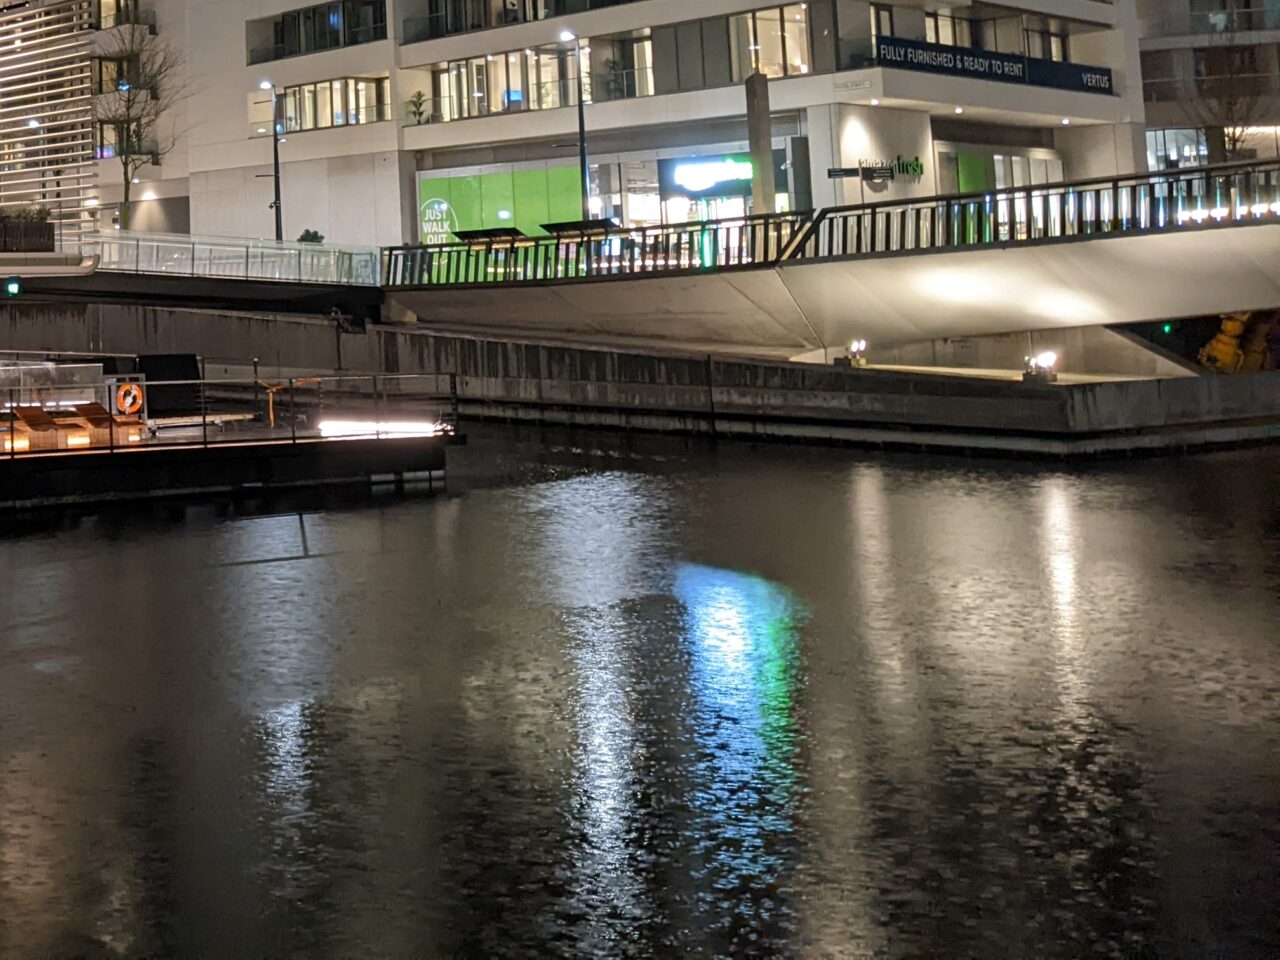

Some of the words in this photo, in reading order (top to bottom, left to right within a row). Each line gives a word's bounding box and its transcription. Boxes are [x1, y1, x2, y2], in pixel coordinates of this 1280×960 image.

[879, 44, 905, 62] FULLY
[907, 48, 954, 68] FURNISHED
[956, 55, 963, 69] &
[964, 56, 990, 73] READY
[991, 61, 1002, 75] TO
[1004, 61, 1024, 77] RENT
[1081, 73, 1110, 89] VERTUS
[424, 208, 447, 220] JUST
[422, 222, 451, 233] WALK
[427, 234, 448, 245] OUT
